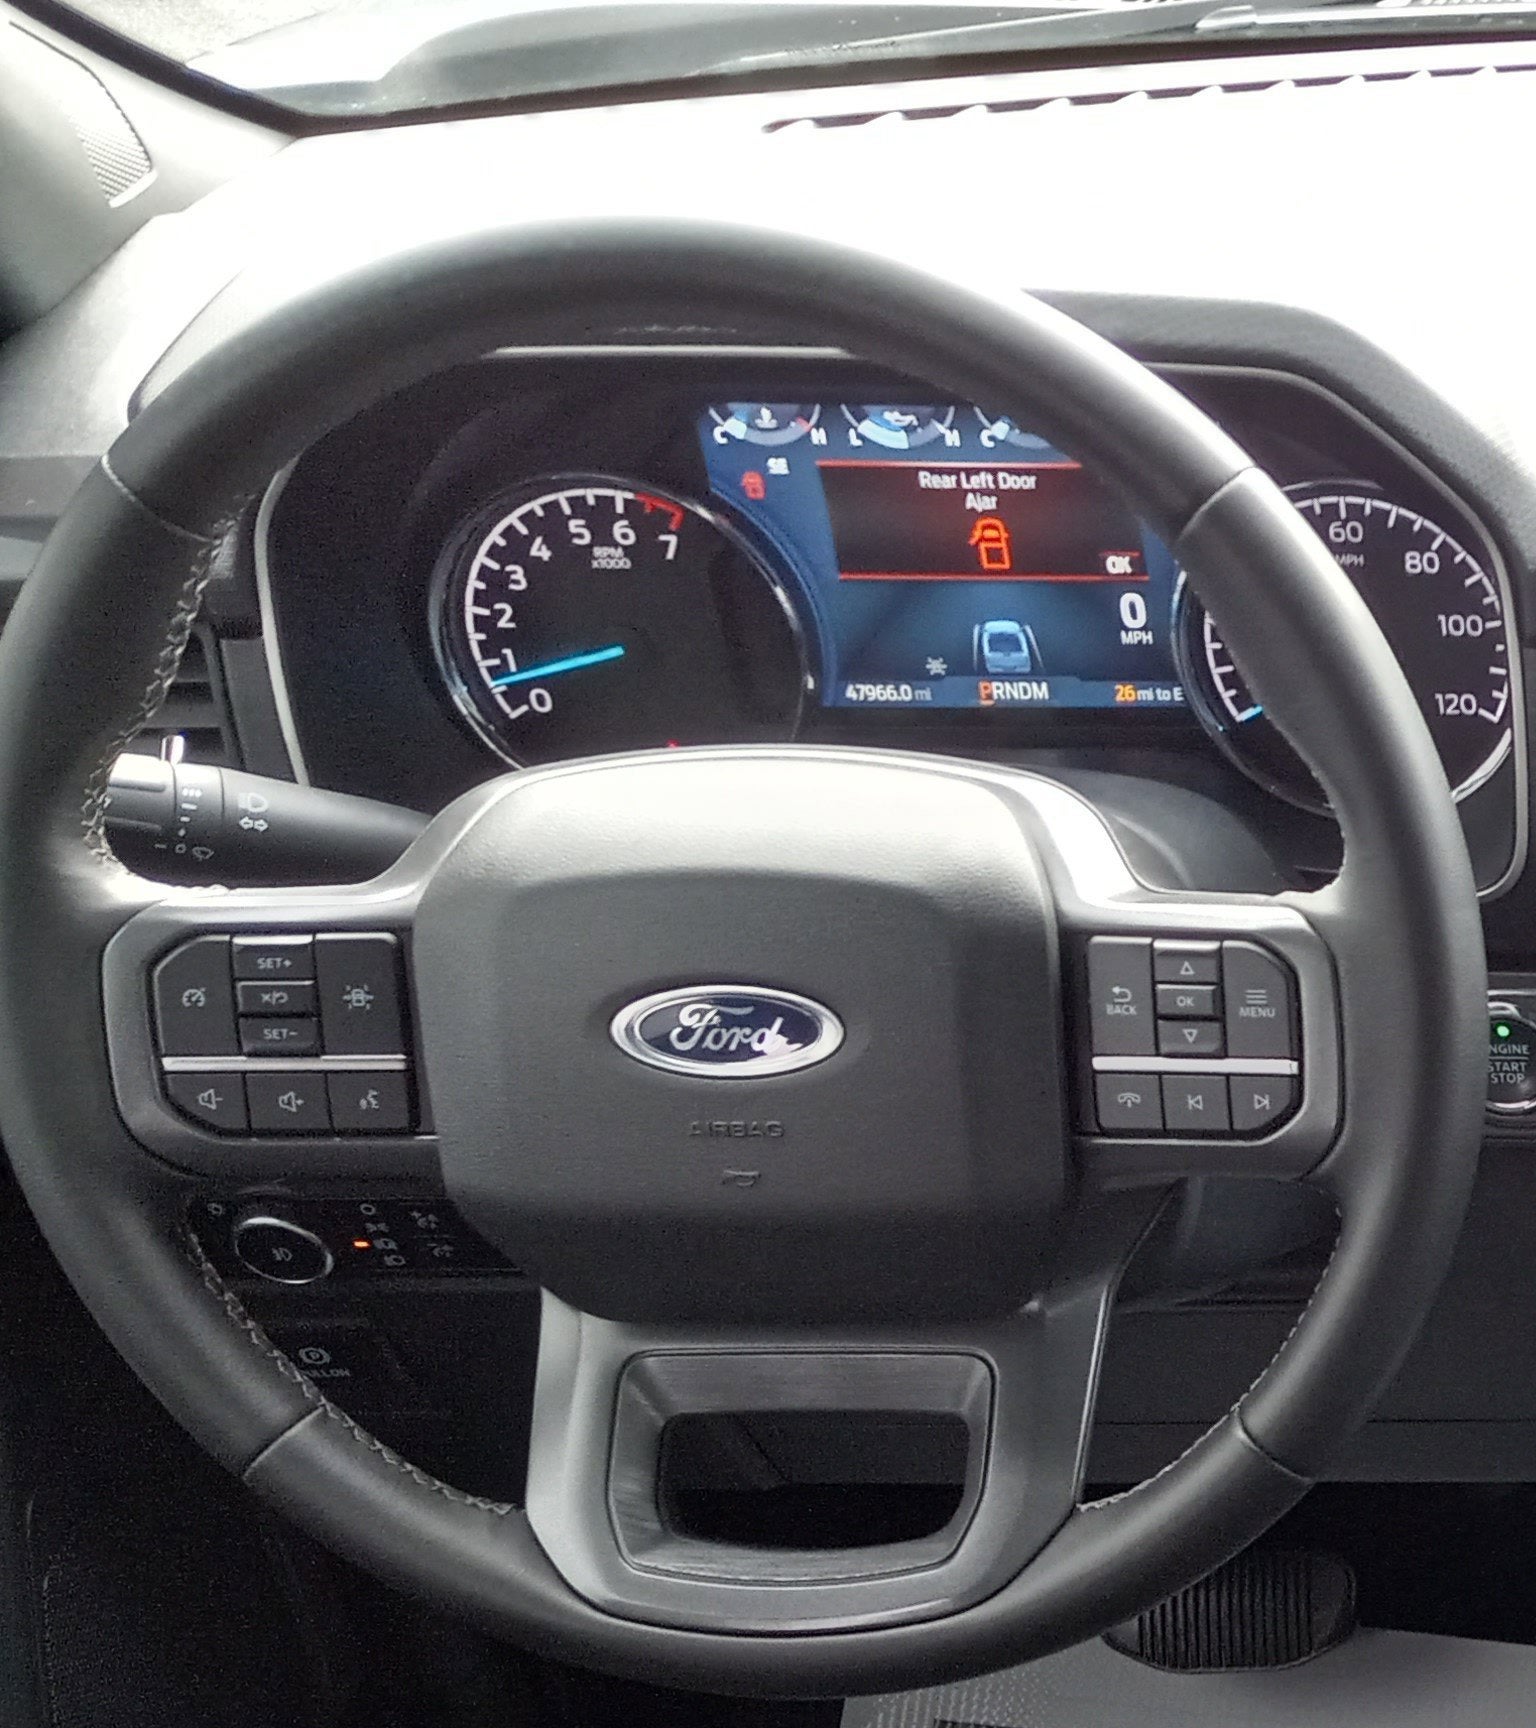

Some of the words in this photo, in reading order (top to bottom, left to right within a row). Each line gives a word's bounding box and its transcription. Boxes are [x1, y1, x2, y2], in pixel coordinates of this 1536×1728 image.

[713, 426, 729, 445] C
[848, 428, 863, 447] L
[918, 471, 957, 489] Rear
[960, 471, 996, 489] Left
[998, 471, 1037, 490] Door
[965, 492, 998, 512] Ajar
[568, 519, 591, 545] 5
[613, 520, 636, 545] 6
[1328, 520, 1364, 543] 60
[529, 536, 552, 562] 4
[592, 546, 624, 558] RPM
[658, 534, 678, 560] 7
[1106, 556, 1133, 574] OK
[1404, 551, 1440, 574] 80
[504, 564, 528, 590] 3
[493, 602, 516, 628] 2
[1119, 592, 1147, 629] 0
[1438, 614, 1484, 638] 100
[1120, 631, 1153, 645] MPH
[529, 688, 553, 713] 0
[845, 684, 912, 701] 47966.0
[914, 686, 932, 701] mi
[1114, 684, 1136, 701] 26
[1137, 687, 1154, 701] mi
[1155, 687, 1171, 701] to
[1435, 693, 1477, 716] 120
[1106, 1004, 1138, 1016] BACK
[1176, 996, 1195, 1008] OK
[1239, 1007, 1276, 1018] MENU
[669, 1003, 803, 1056] Ford
[1489, 1043, 1530, 1055] NGINE
[1490, 1072, 1525, 1084] STOP
